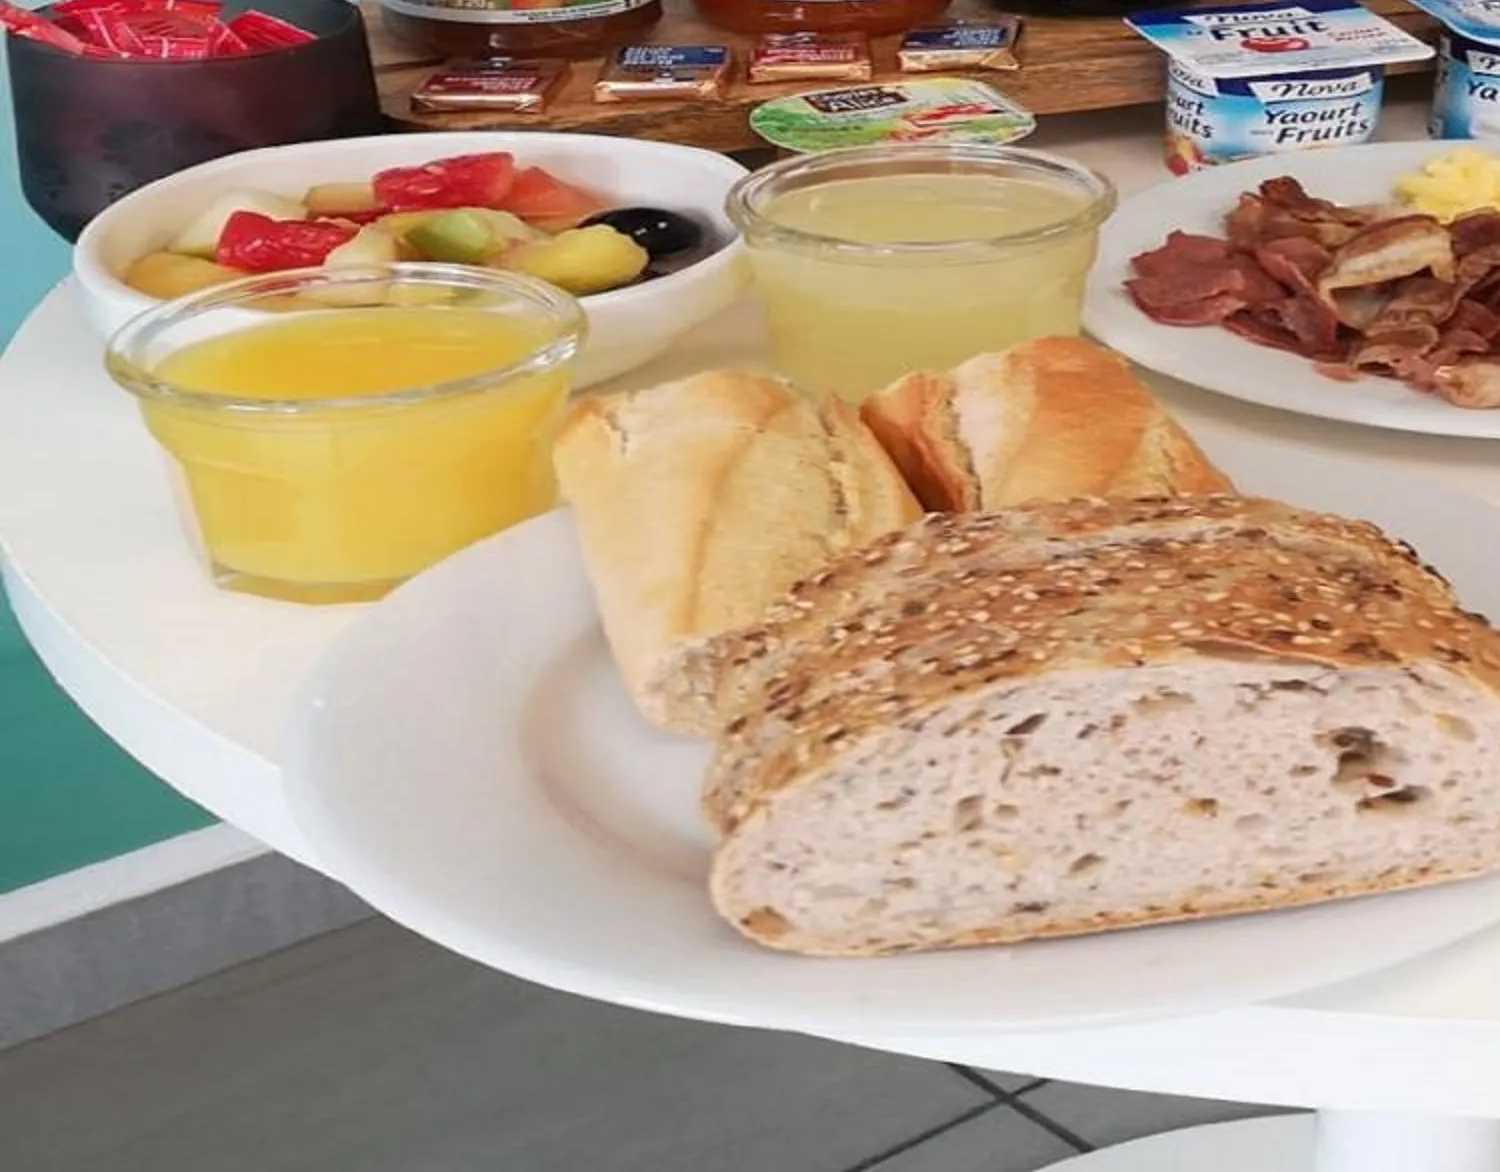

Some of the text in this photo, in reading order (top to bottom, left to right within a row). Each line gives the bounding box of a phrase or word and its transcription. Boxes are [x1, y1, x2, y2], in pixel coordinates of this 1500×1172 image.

[1209, 18, 1330, 41] Fruit
[1270, 80, 1360, 98] Nova
[1263, 100, 1363, 126] Yaourt
[1275, 119, 1370, 145] Fruits
